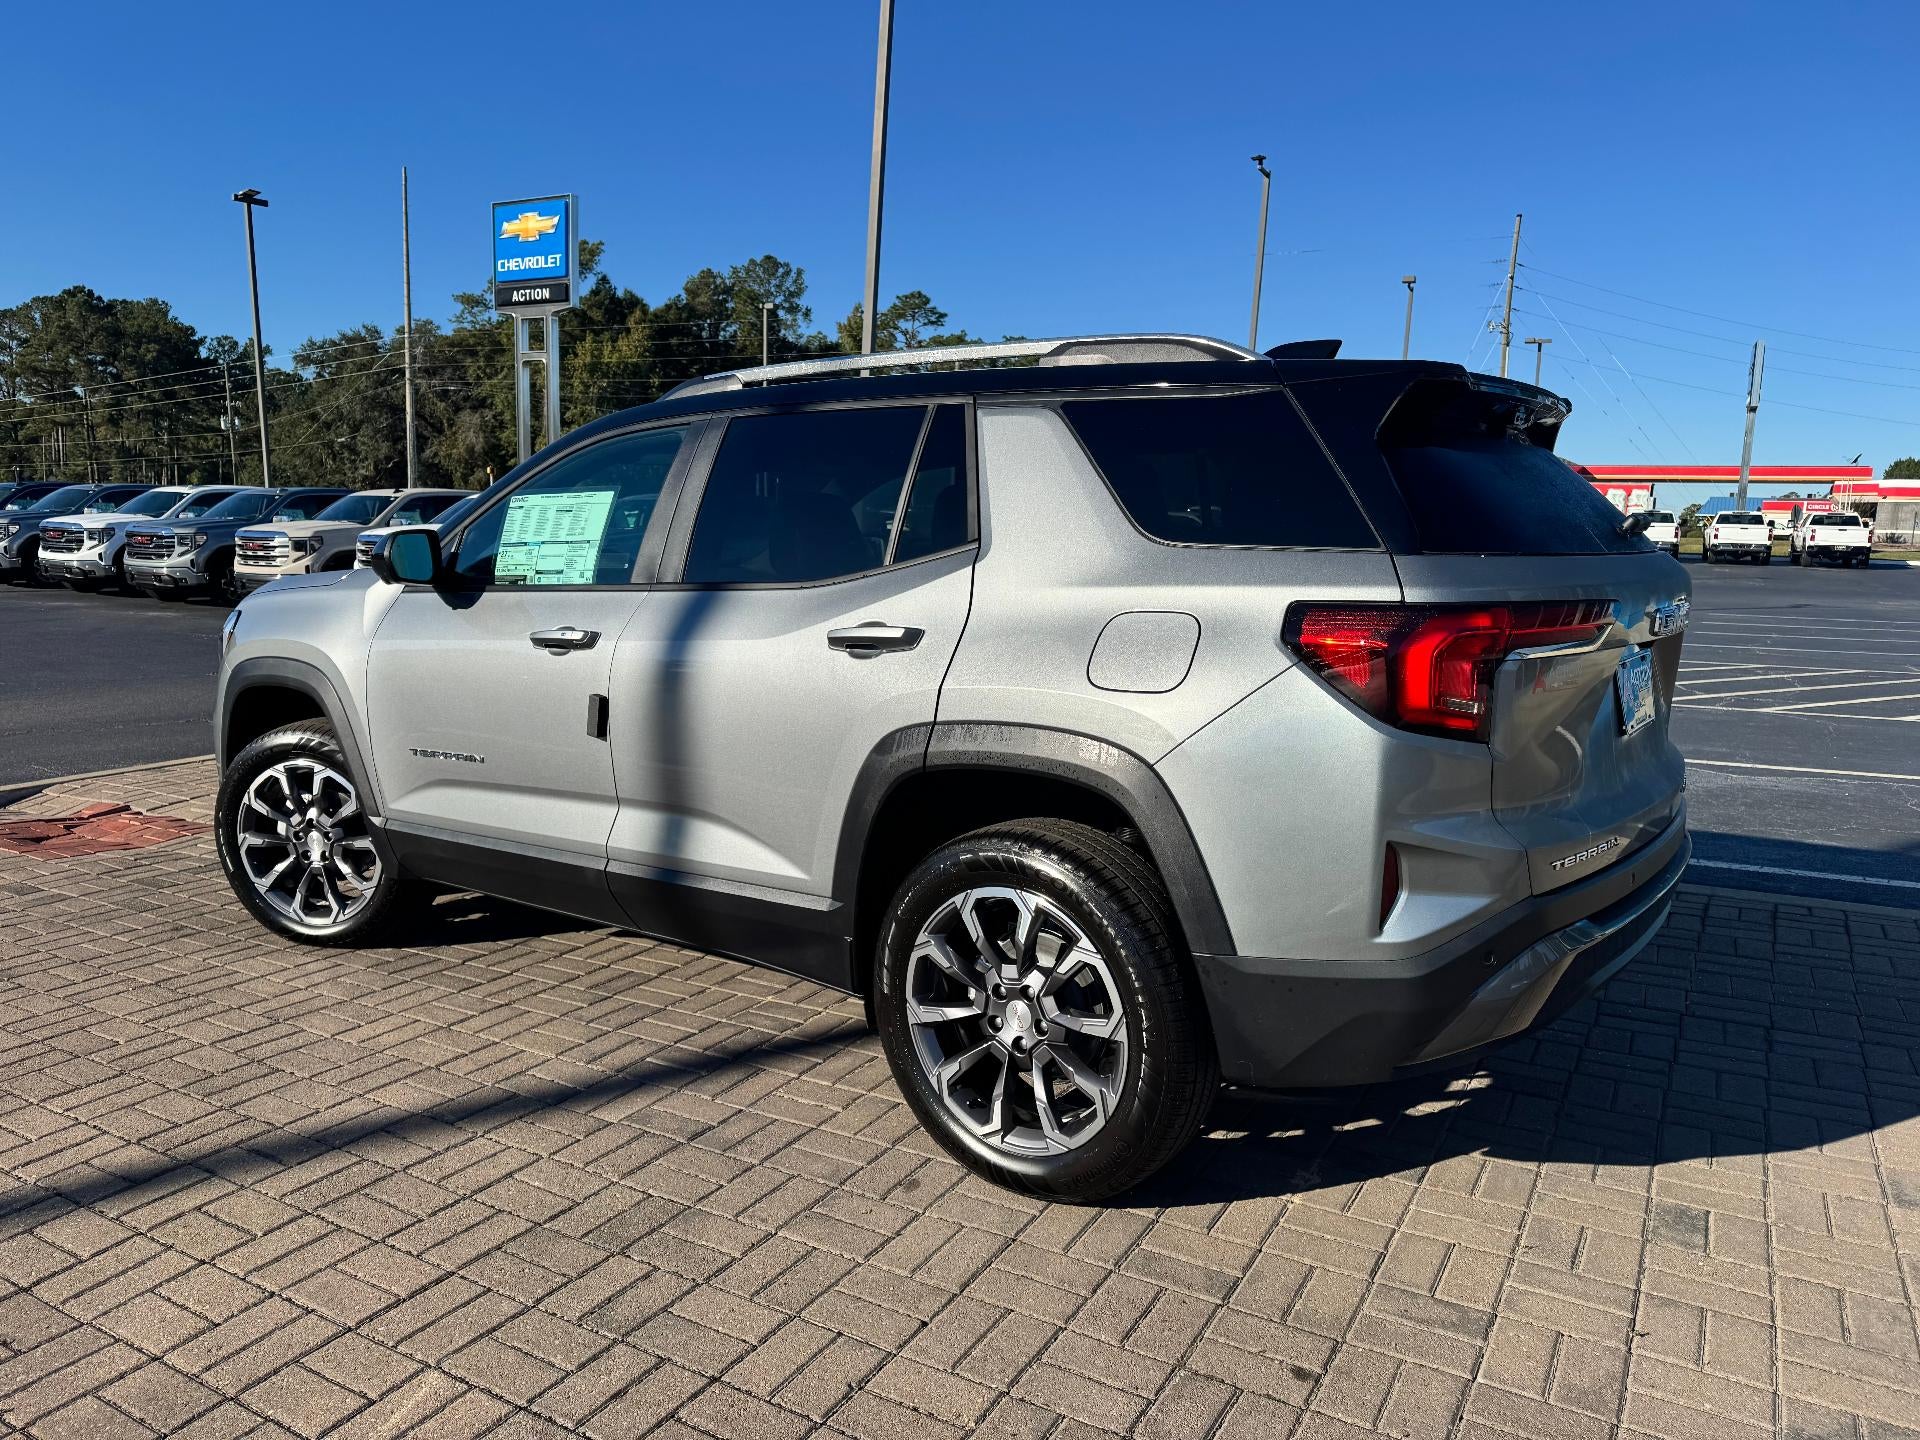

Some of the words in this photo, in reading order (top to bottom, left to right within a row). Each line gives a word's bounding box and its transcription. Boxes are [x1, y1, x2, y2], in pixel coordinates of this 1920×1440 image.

[497, 253, 562, 272] CHEVROLET
[512, 287, 550, 302] ACTION
[408, 748, 485, 764] TERRAIN
[1551, 836, 1620, 871] TERRAIN
